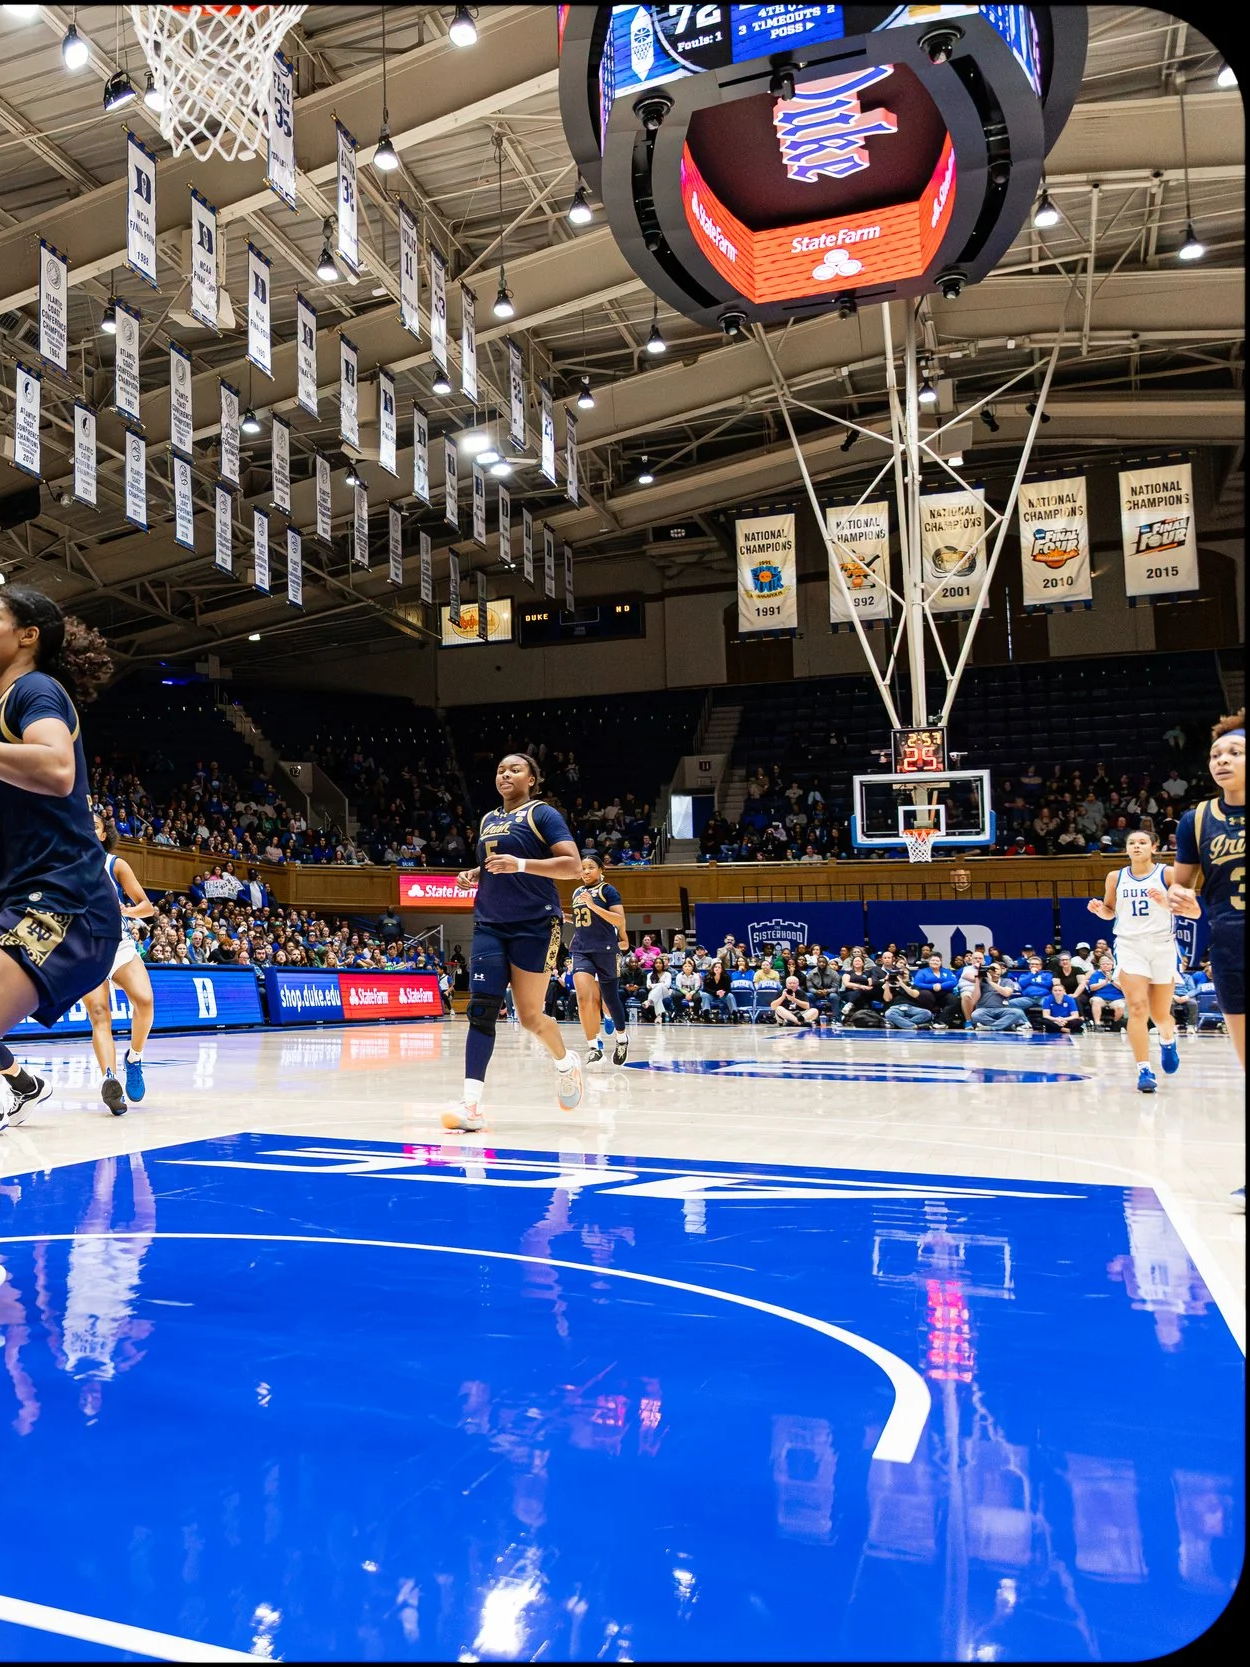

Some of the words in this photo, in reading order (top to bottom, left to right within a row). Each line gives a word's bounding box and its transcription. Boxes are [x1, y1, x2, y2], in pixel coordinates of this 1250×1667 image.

[669, 5, 722, 34] 72
[738, 24, 747, 36] 3
[752, 7, 821, 31] TIMEOUTS
[770, 23, 804, 39] POSS
[677, 34, 714, 52] Fouls:
[715, 31, 723, 42] 1
[275, 97, 292, 138] 35
[1131, 480, 1182, 497] NATIONAL
[1028, 493, 1077, 508] NATIONAL
[1126, 493, 1190, 511] CHAMPIONS
[1023, 506, 1084, 523] CHAMPIONS
[744, 529, 787, 542] NATIONAL
[837, 528, 886, 544] HAMPIONS
[740, 540, 792, 555] CHAMPIONS
[1146, 566, 1179, 579] 2015
[1043, 576, 1074, 588] 2010
[942, 586, 971, 598] 2001
[853, 596, 875, 607] 992
[525, 613, 549, 622] DUKE
[755, 606, 781, 617] 1991
[904, 747, 938, 771] 25
[1123, 889, 1148, 898] DUK
[1132, 900, 1149, 916] 12
[574, 908, 592, 928] 23
[753, 930, 803, 943] SISTERHOOD
[280, 984, 341, 1013] shop.duke.edu
